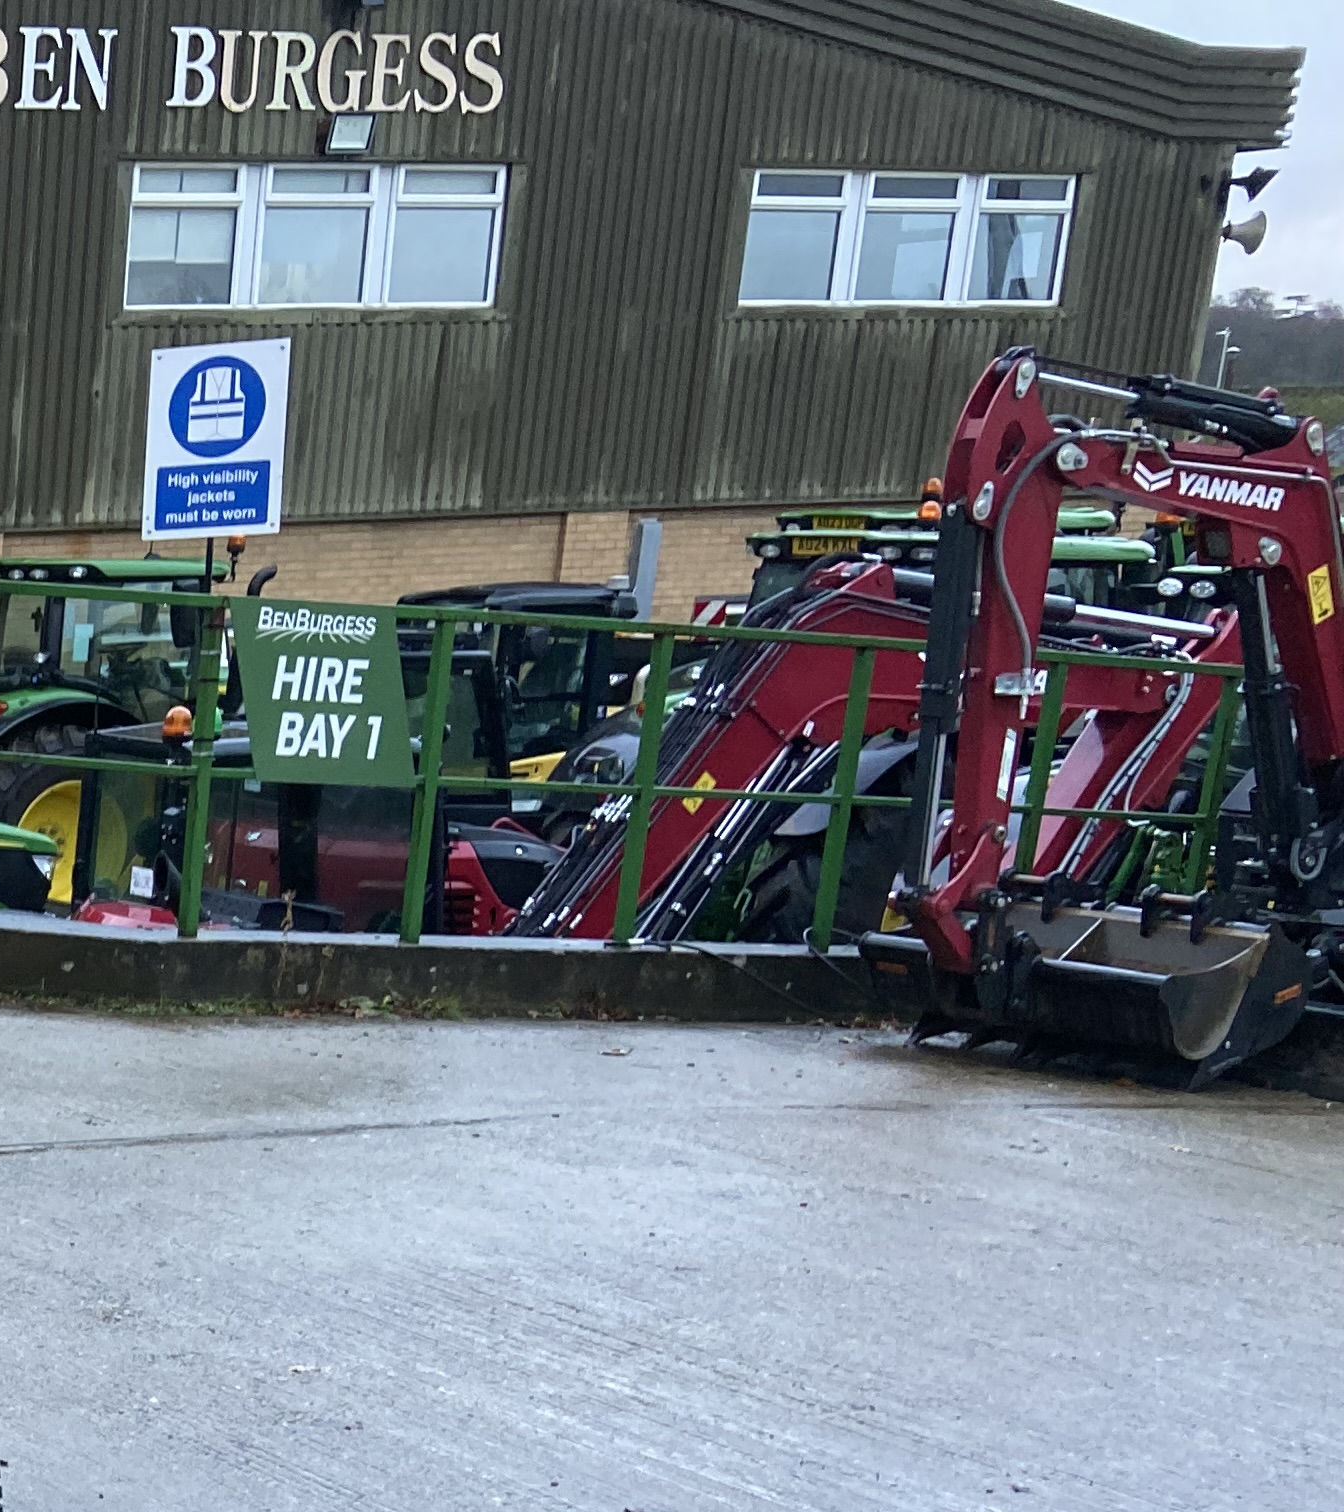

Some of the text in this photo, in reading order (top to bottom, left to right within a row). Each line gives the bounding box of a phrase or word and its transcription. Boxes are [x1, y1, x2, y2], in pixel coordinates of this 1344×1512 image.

[165, 25, 504, 114] BURGESS
[167, 469, 259, 489] High visibility
[187, 490, 236, 507] jackets
[1178, 470, 1285, 511] YANMAR
[165, 508, 256, 524] must be worn
[272, 655, 370, 704] HIRE
[275, 711, 383, 760] BAY 1
